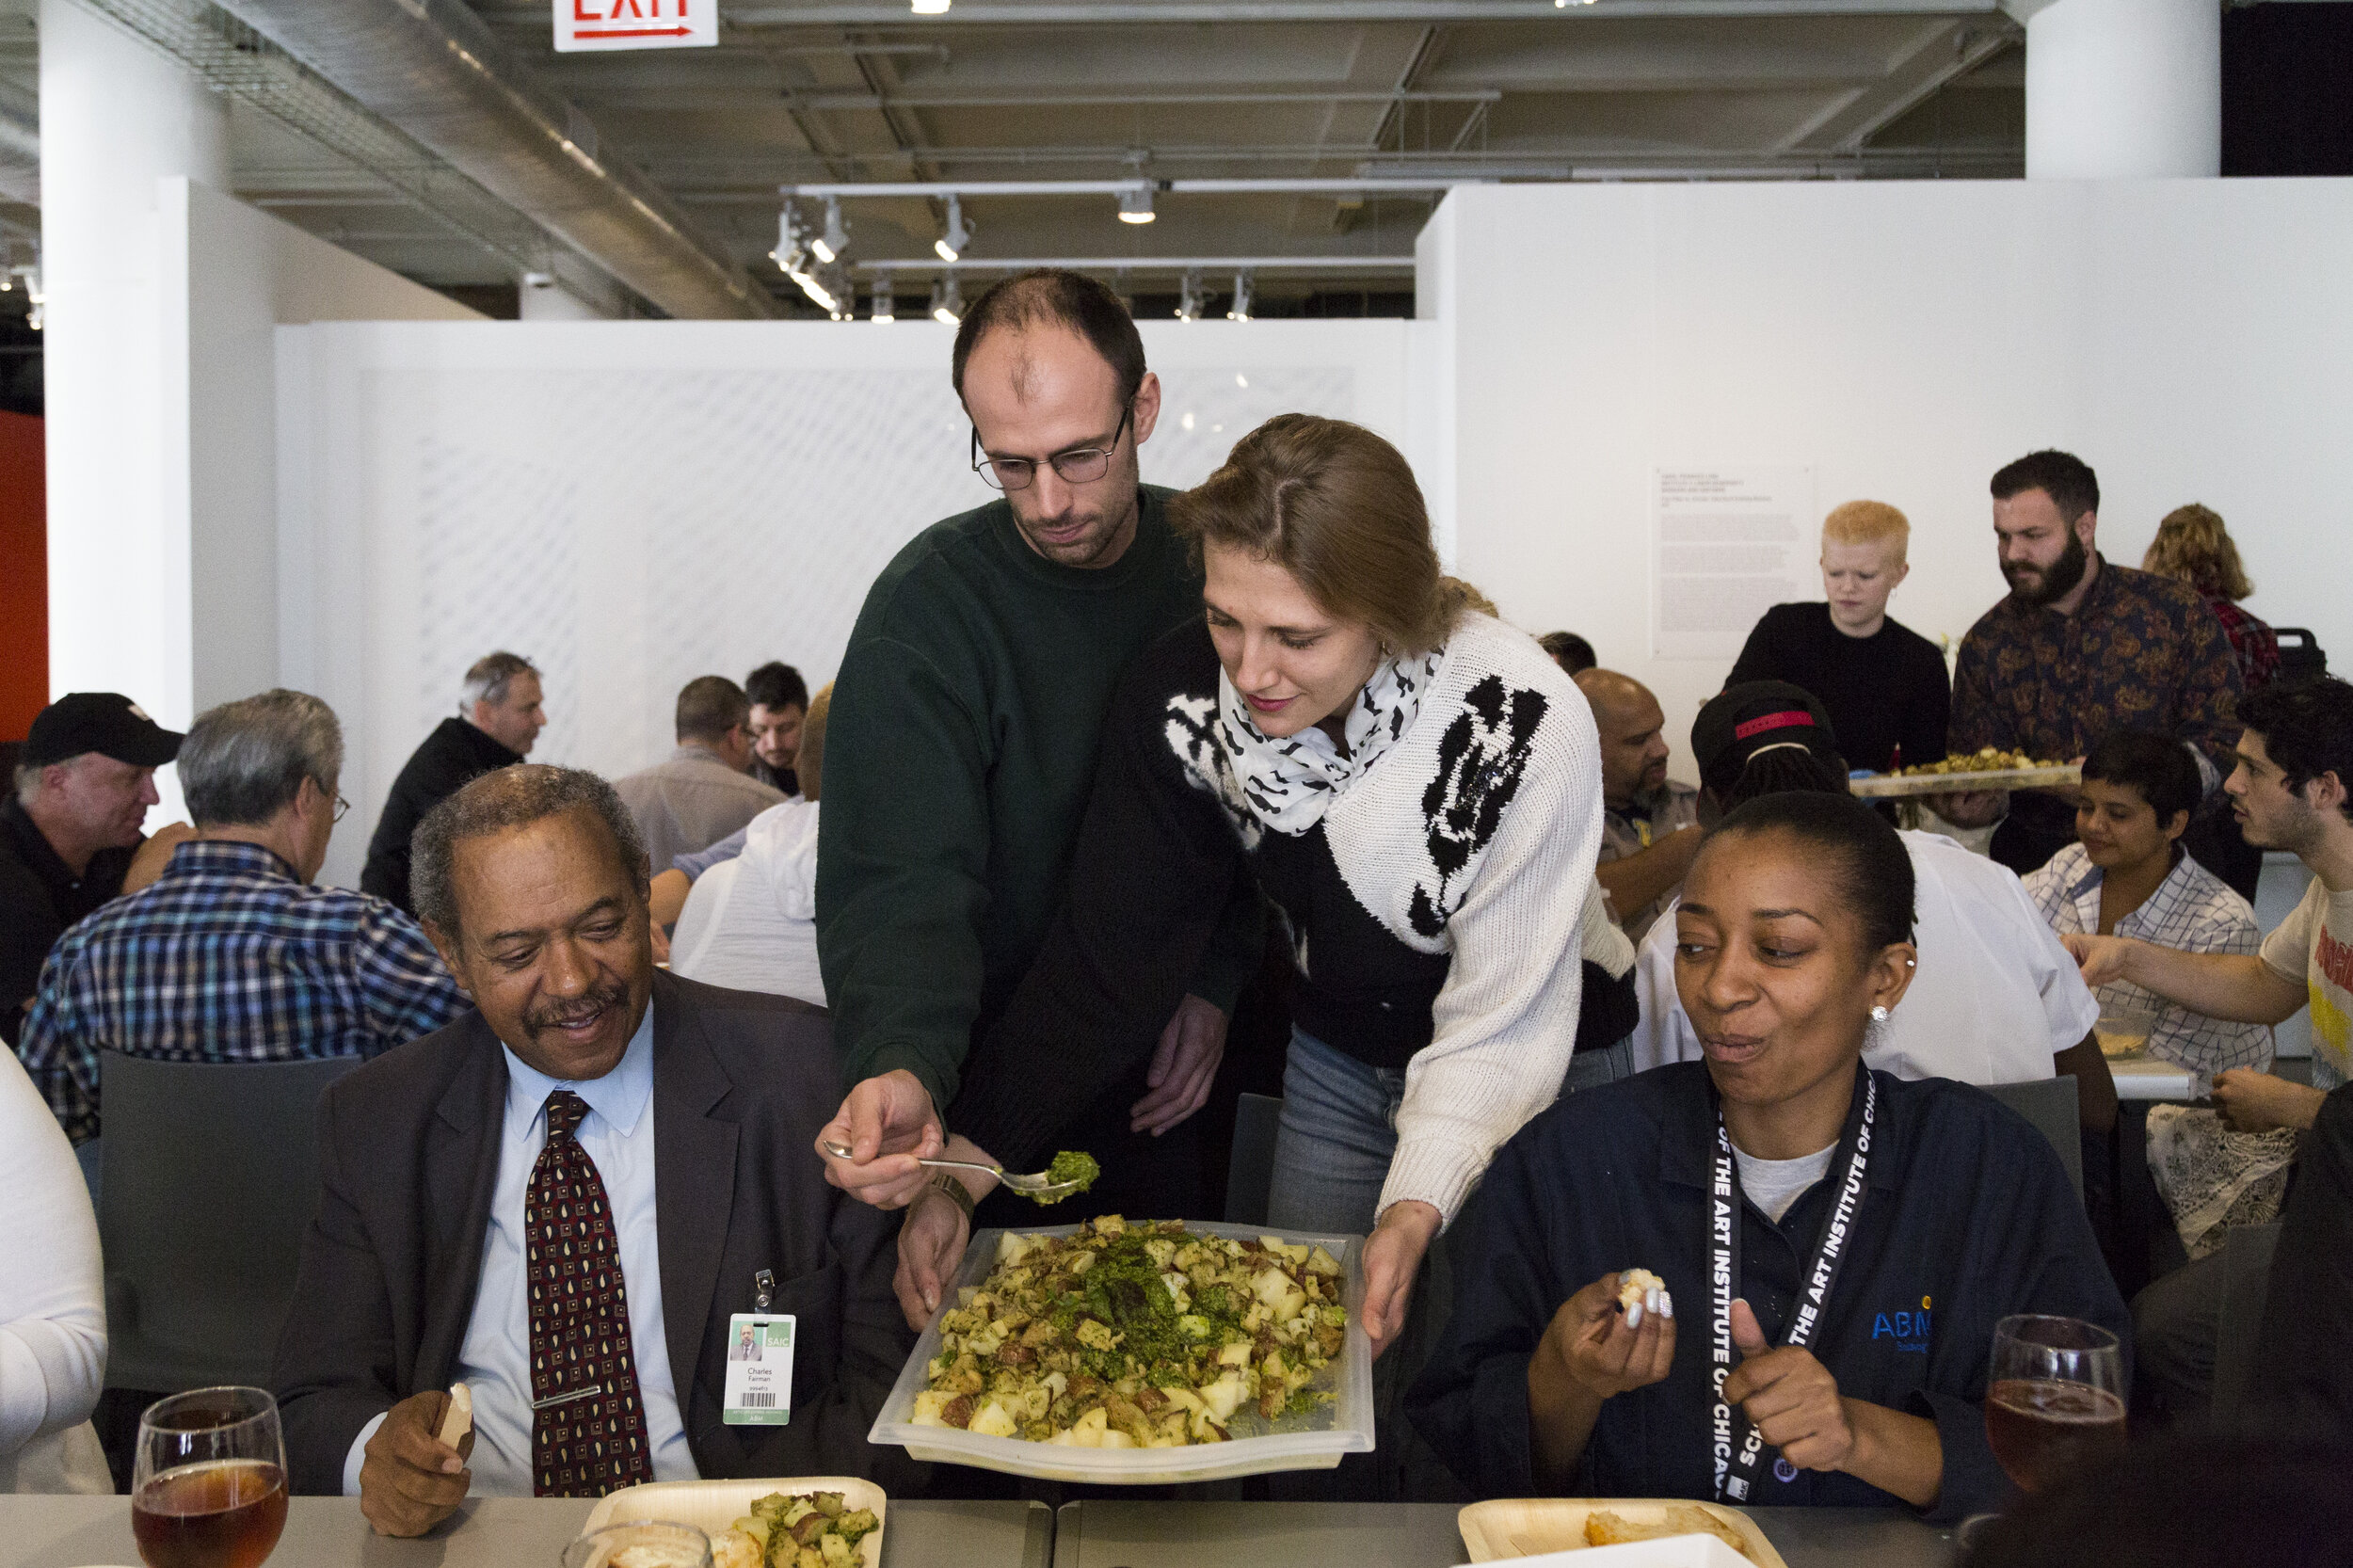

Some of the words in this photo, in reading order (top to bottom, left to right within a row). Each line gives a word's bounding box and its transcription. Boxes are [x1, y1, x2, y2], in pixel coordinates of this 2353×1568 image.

[1718, 1126, 1731, 1154] OF
[1714, 1157, 1732, 1197] THE
[1714, 1199, 1731, 1245] ART
[1788, 1304, 1819, 1346] THE
[1807, 1257, 1833, 1305] ART
[1822, 1153, 1867, 1259] INSTITUTE
[1856, 1124, 1873, 1153] OF
[1713, 1249, 1731, 1364] INSTITUTE
[767, 1337, 790, 1347] SAIC
